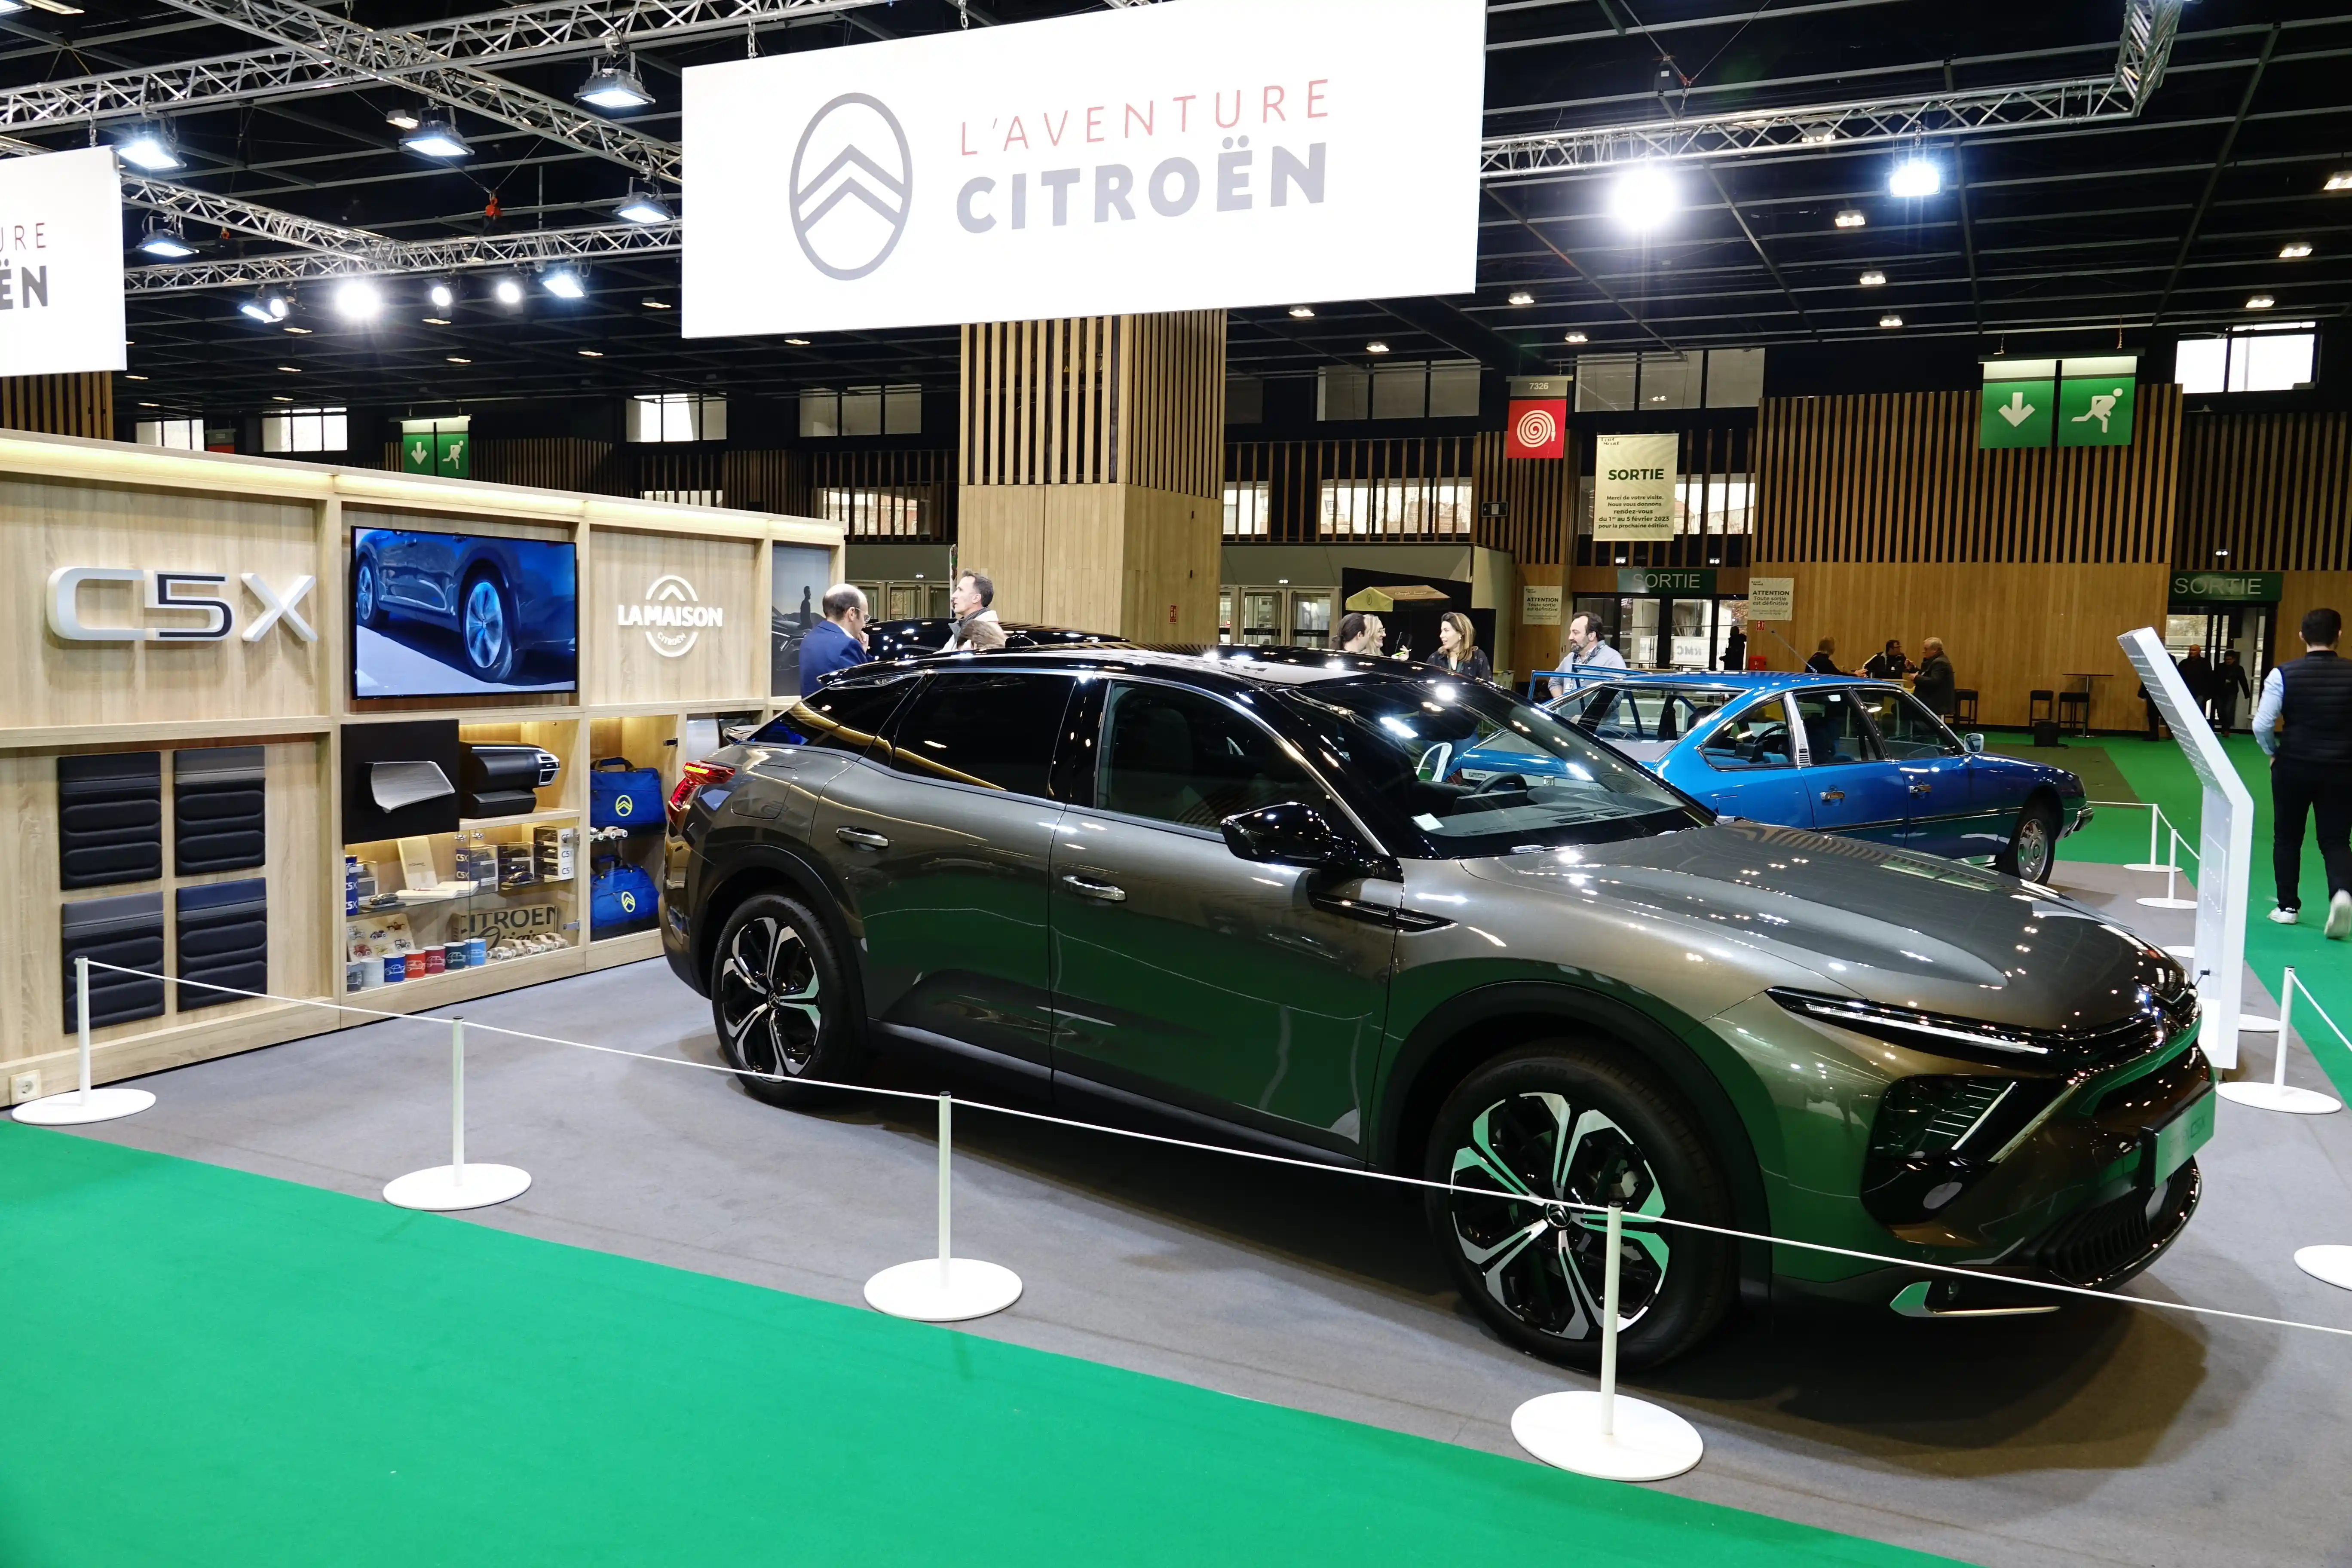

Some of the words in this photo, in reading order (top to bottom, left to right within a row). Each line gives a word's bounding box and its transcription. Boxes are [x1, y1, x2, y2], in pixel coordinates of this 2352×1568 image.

[962, 79, 1328, 155] L'AVENTURE
[956, 135, 1326, 233] CITROËN
[1608, 469, 1664, 480] SORTIE
[1633, 573, 1700, 588] SORTIE
[2174, 578, 2262, 594] SORTIE
[46, 566, 318, 642] C5X
